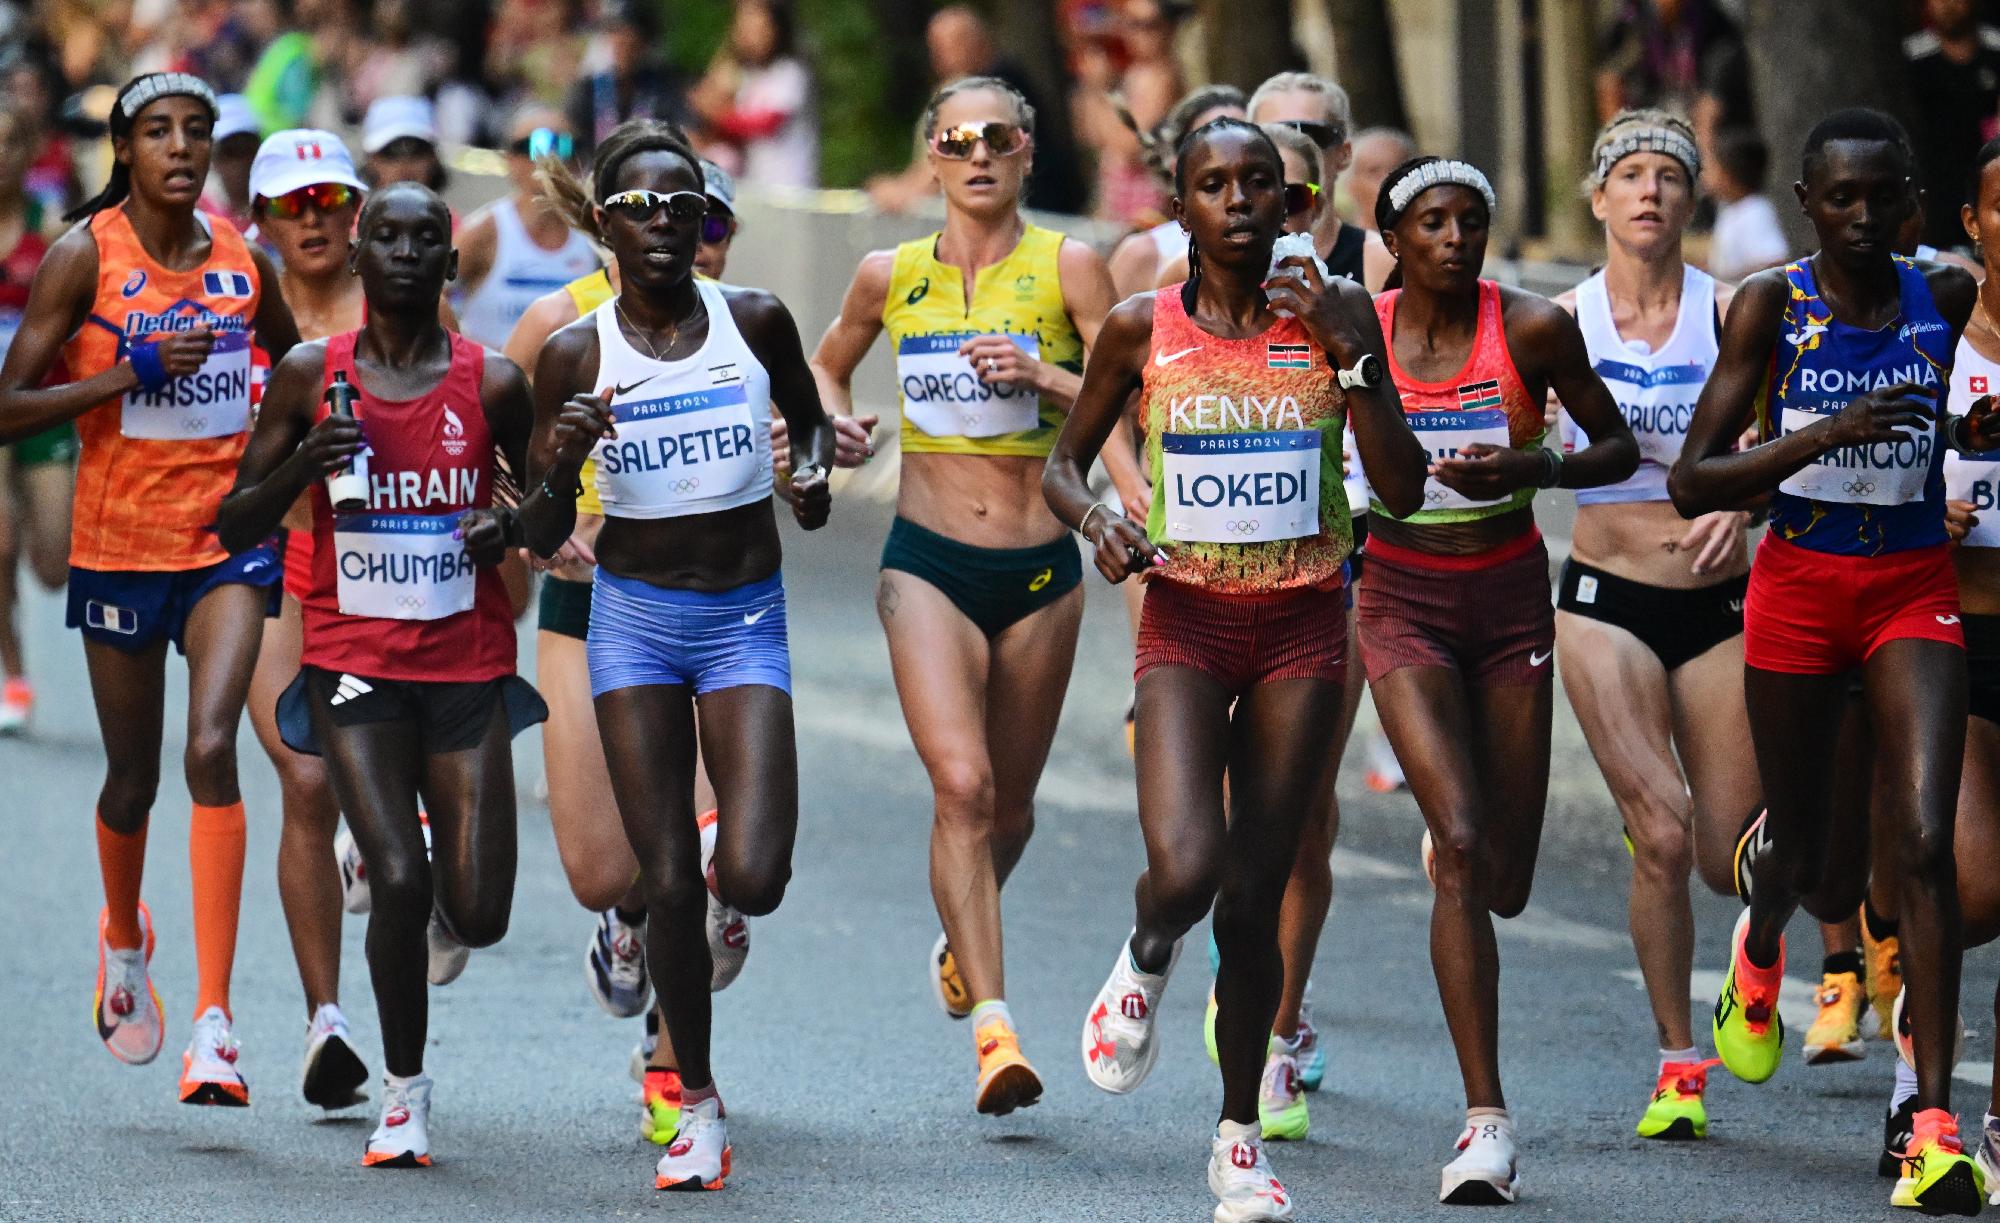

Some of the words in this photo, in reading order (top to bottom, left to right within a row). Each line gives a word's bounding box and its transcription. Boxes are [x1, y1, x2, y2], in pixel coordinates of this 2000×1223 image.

[930, 338, 963, 350] PARI
[1801, 363, 1938, 393] ROMANIA
[633, 402, 672, 416] PARIS
[674, 396, 709, 410] 2024
[1170, 395, 1304, 432] KENYA
[1822, 400, 1848, 410] PAR
[1406, 418, 1427, 427] RIS
[1431, 417, 1466, 427] 2024
[602, 424, 753, 475] SALPETER
[1200, 438, 1240, 450] PARIS
[1244, 437, 1280, 448] 2024
[1785, 430, 1931, 469] RINGOR
[366, 467, 479, 510] HRAIN
[1176, 469, 1307, 508] LOKEDI
[1972, 480, 2000, 511] B
[371, 519, 408, 530] PARIS
[413, 520, 446, 531] 2024
[340, 551, 473, 584] CHUMBA
